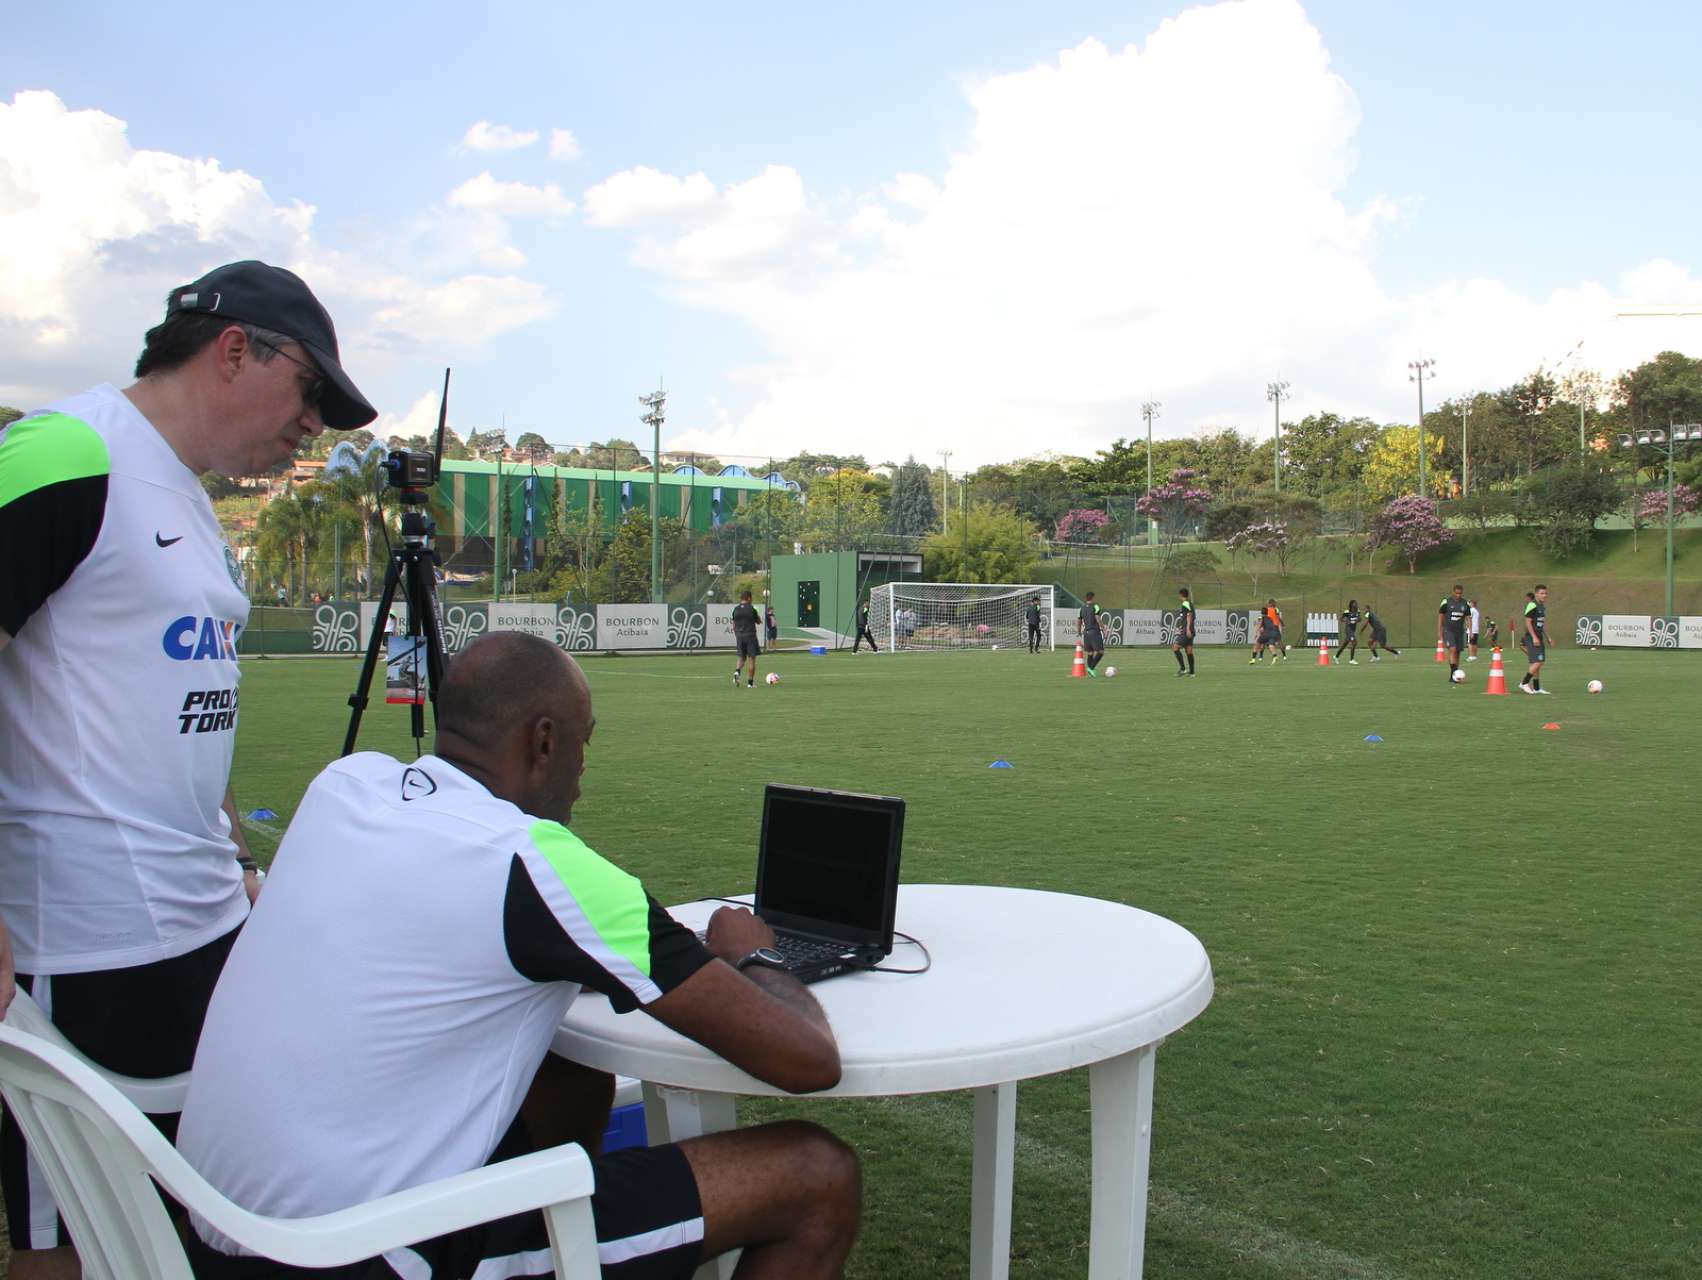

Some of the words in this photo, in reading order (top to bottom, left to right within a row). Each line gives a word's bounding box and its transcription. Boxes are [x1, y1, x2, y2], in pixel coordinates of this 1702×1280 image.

[497, 616, 555, 626] BOURBON
[606, 617, 660, 627] BOURBON
[1055, 619, 1080, 627] BOUR
[1129, 619, 1161, 627] BOURBON
[1195, 619, 1223, 627] OURBON
[616, 628, 649, 637] Atibaia
[163, 616, 241, 661] CAIX
[182, 689, 232, 711] PRO
[178, 711, 235, 734] TORK
